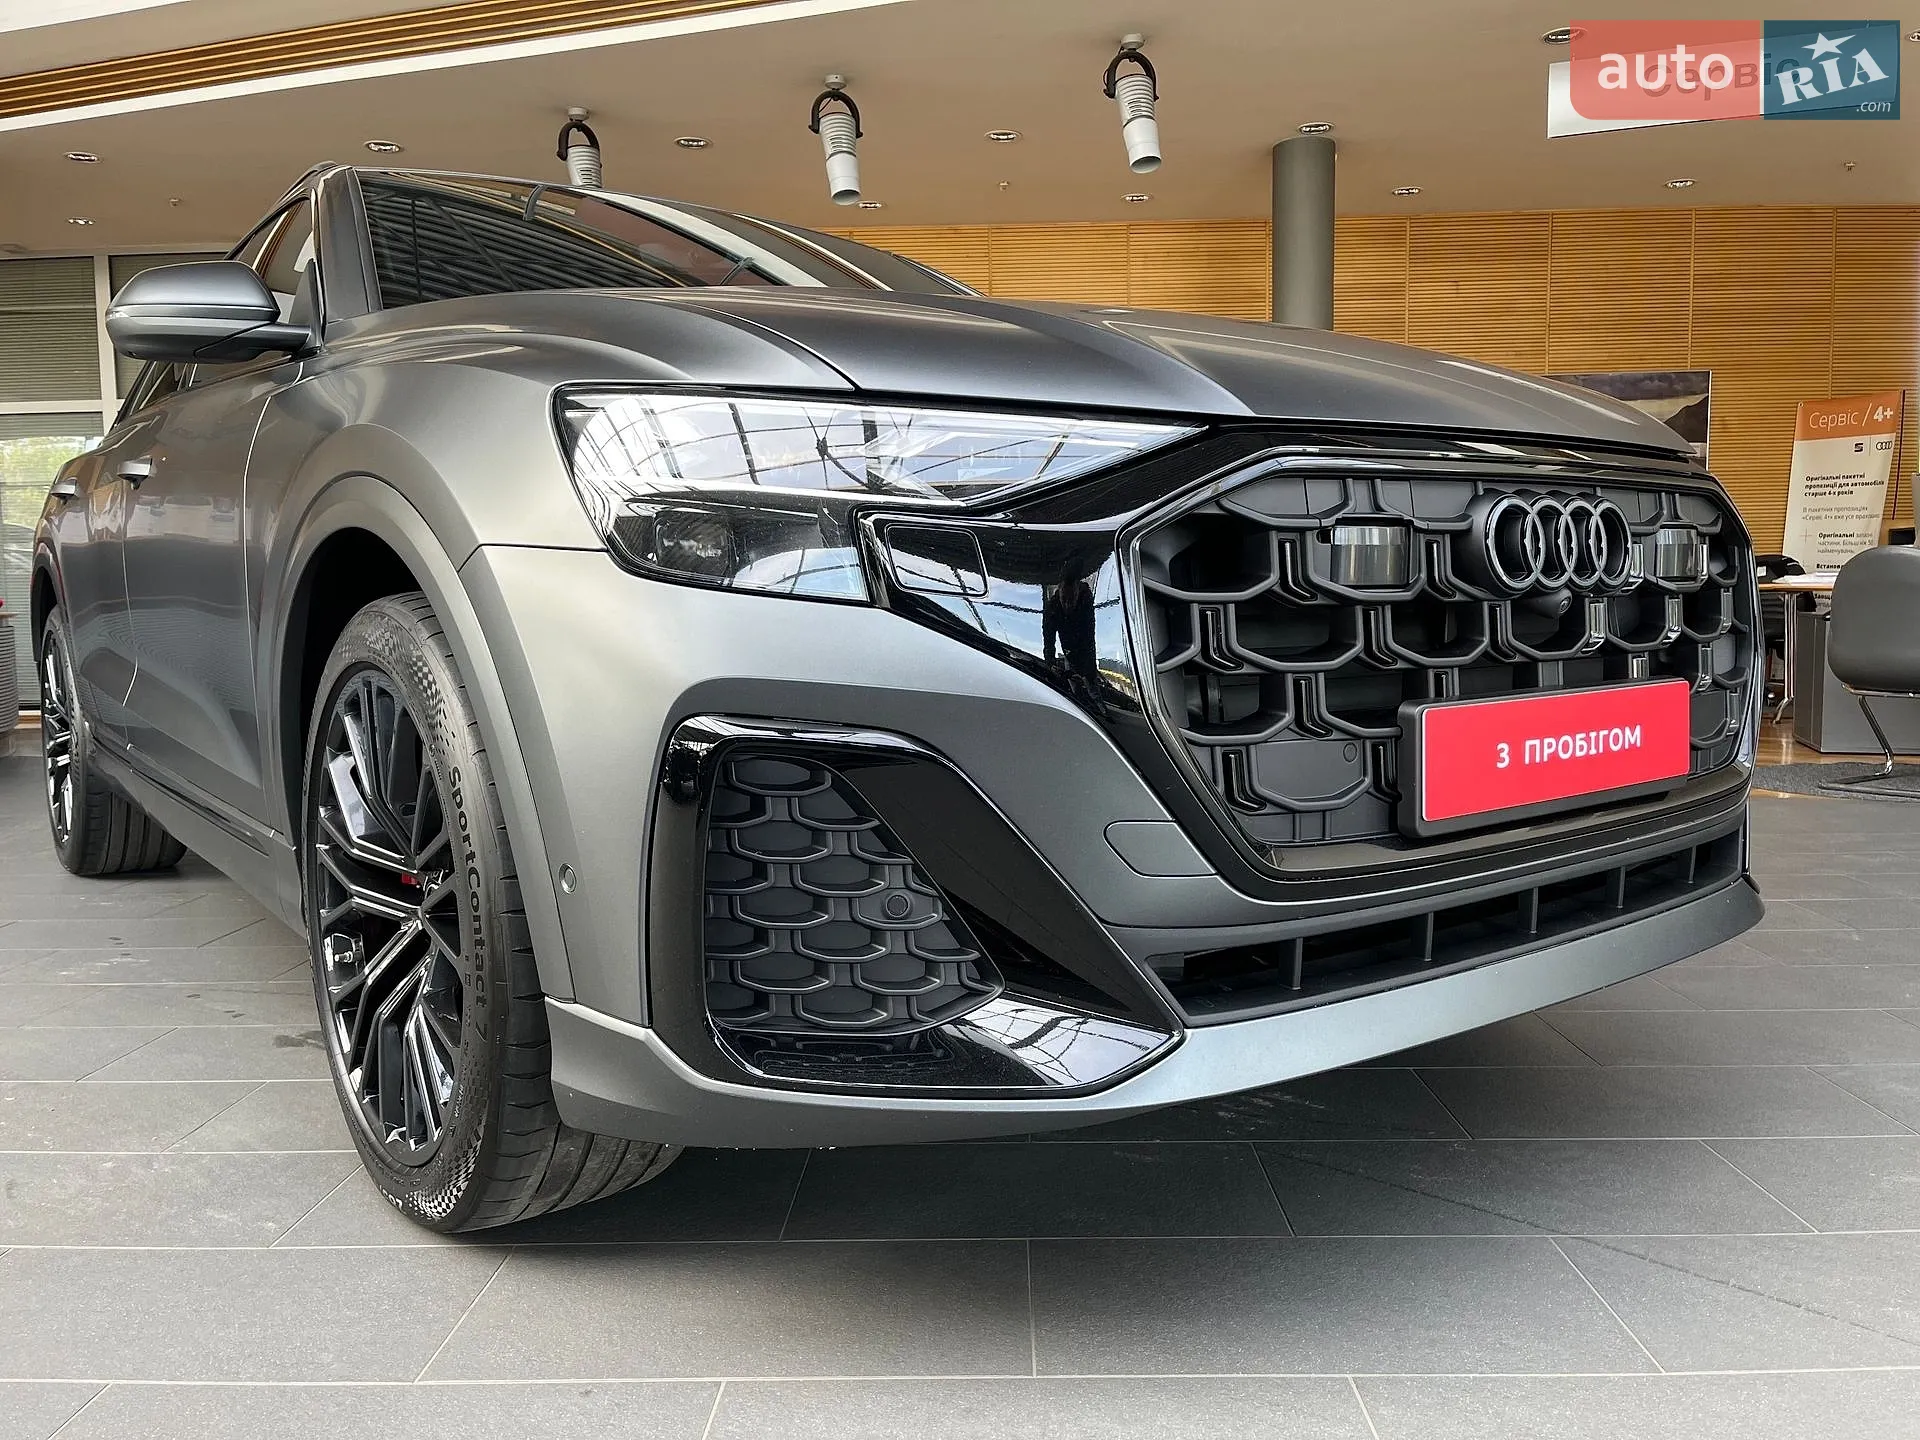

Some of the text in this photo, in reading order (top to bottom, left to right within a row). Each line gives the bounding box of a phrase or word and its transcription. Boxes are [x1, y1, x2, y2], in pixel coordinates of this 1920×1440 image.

[1809, 410, 1859, 432] Сервіс
[1873, 405, 1894, 422] 4+
[1806, 474, 1841, 482] Оригінальні
[1838, 481, 1850, 489] для
[1837, 489, 1854, 497] років
[1818, 532, 1855, 540] Оригінальні
[1524, 724, 1642, 765] ПРОБІГОМ
[448, 766, 488, 1009] SportContact
[474, 1021, 489, 1044] 7
